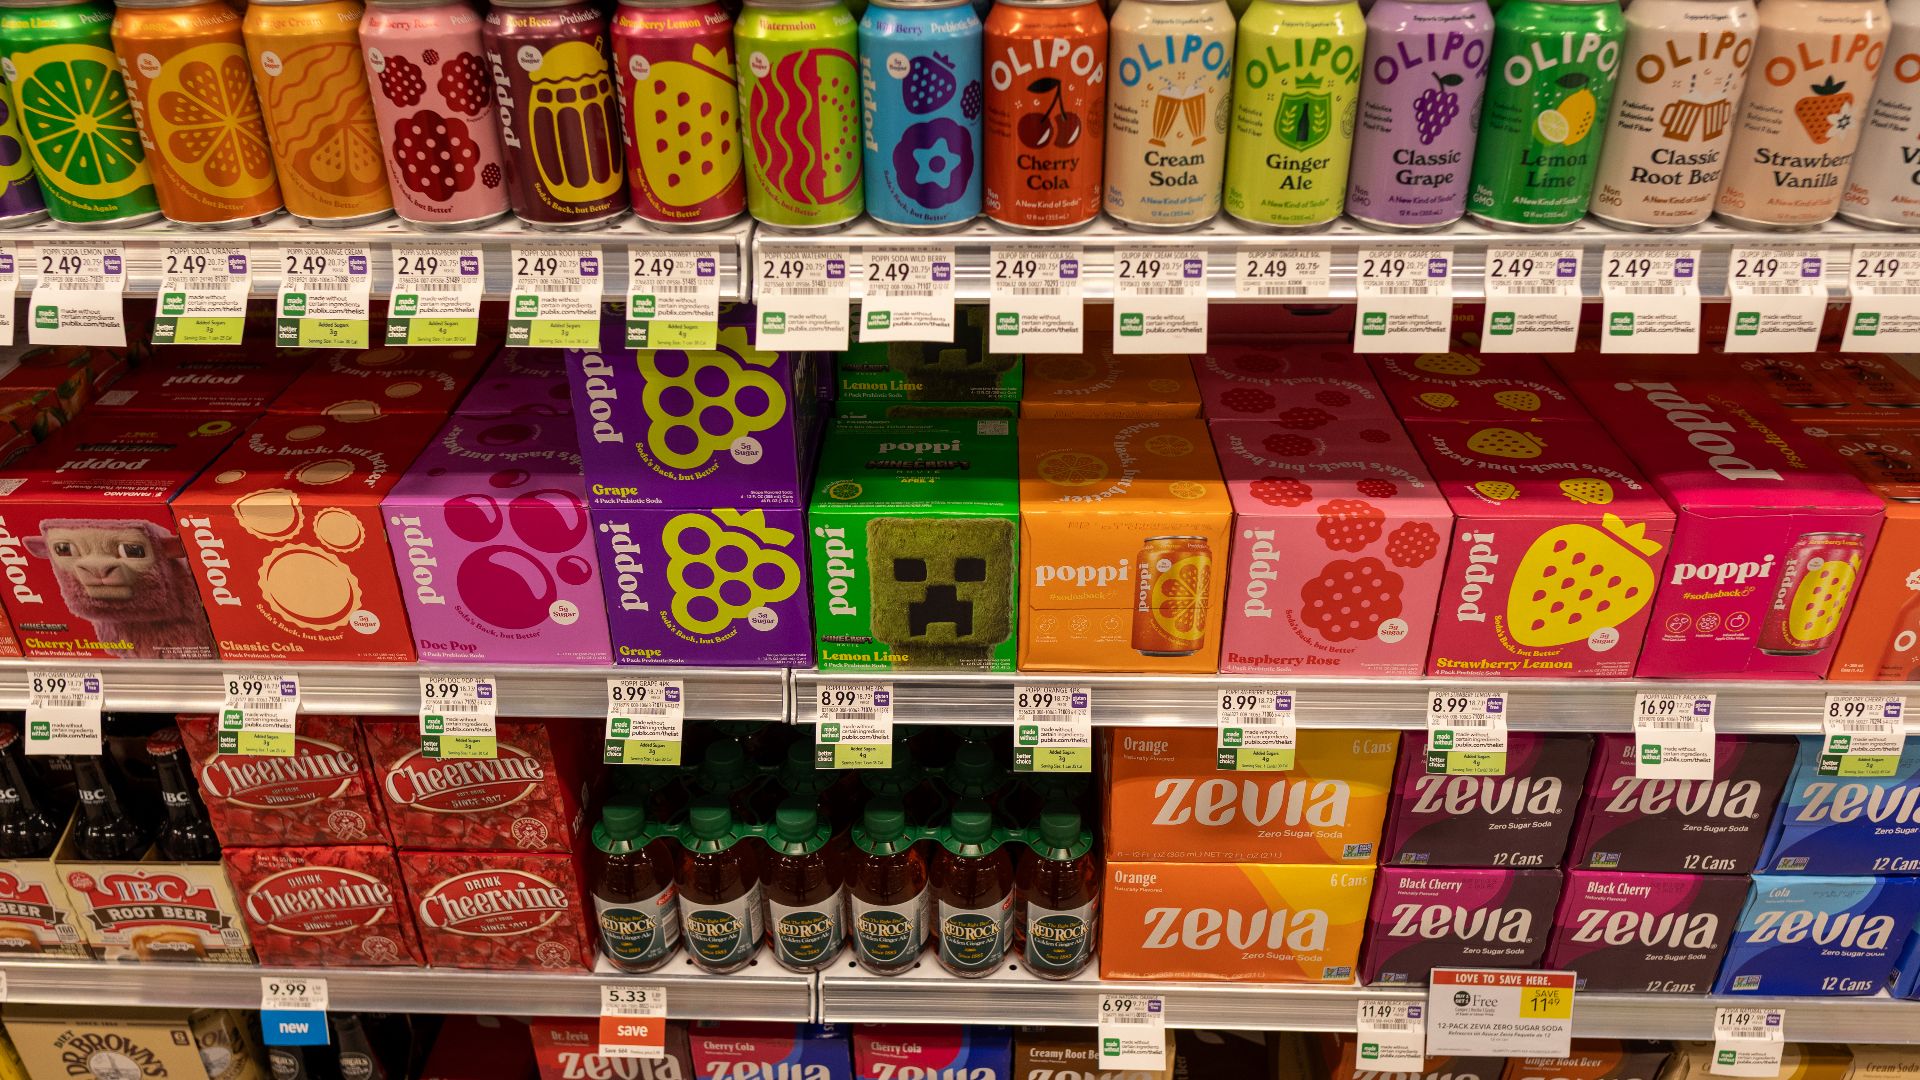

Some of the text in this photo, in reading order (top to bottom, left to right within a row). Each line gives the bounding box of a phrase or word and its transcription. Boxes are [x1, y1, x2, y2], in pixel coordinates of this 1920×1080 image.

[665, 18, 700, 30] Lemon
[759, 19, 816, 31] Watermelon
[990, 38, 1104, 91] OLIPOP
[1017, 153, 1080, 173] Cherry
[1144, 150, 1205, 168] Cream
[1266, 153, 1331, 174] Ginger
[1393, 149, 1461, 167] Classic
[1521, 149, 1587, 167] Lemon
[1652, 149, 1720, 165] Classic
[1026, 174, 1069, 191] Cola
[1149, 171, 1199, 188] Soda
[1279, 175, 1312, 190] Ale
[1396, 170, 1454, 189] Grape
[1527, 172, 1575, 189] Lime
[1631, 168, 1686, 184] Root
[1772, 171, 1838, 188] Vanilla
[1476, 184, 1494, 196] Non
[43, 257, 81, 273] 2.49
[167, 256, 206, 273] 2.49
[287, 256, 326, 274] 2.49
[398, 257, 438, 275] 2.49
[517, 257, 557, 275] 2.49
[634, 258, 674, 276] 2.49
[764, 260, 804, 278] 2.49
[869, 263, 910, 281] 2.49
[995, 260, 1037, 278] 2.49
[1119, 260, 1160, 278] 2.49
[1247, 260, 1287, 278] 2.49
[1363, 259, 1405, 278] 2.49
[1491, 259, 1534, 278] 2.49
[1608, 259, 1651, 278] 2.49
[1735, 259, 1778, 278] 2.49
[1856, 259, 1899, 278] 2.49
[843, 380, 923, 392] Lemon Lime
[740, 443, 751, 451] 5g
[879, 440, 961, 454] poppi
[592, 484, 638, 498] Grape
[180, 514, 242, 606] poppi
[391, 513, 446, 607] poppi
[600, 521, 649, 612] poppi
[815, 527, 857, 616] poppi
[1035, 559, 1129, 587] poppi
[1244, 528, 1280, 618] poppi
[1457, 529, 1499, 622] poppi
[1671, 554, 1776, 585] poppi
[1683, 590, 1741, 600] #sodasback
[25, 638, 134, 651] Cherry Limeade
[221, 641, 269, 652] Classic
[275, 641, 304, 652] Cola
[420, 639, 477, 654] Doc Pop
[619, 645, 661, 658] Grape
[822, 650, 909, 662] Lemon Lime
[1228, 653, 1341, 667] Raspberry Rose
[1436, 657, 1524, 672] Strawberry
[1527, 658, 1574, 670] Lemon
[33, 679, 67, 693] 8.99
[229, 681, 262, 695] 8.99
[425, 684, 458, 698] 8.99
[612, 686, 647, 701] 8.99
[821, 691, 855, 705] 8.99
[1019, 693, 1053, 708] 8.99
[1222, 695, 1257, 710] 8.99
[1433, 698, 1468, 712] 8.99
[1640, 700, 1675, 715] 16.99
[1829, 702, 1865, 717] 8.99
[1123, 736, 1169, 752] Orange
[1352, 739, 1392, 754] 6 Cans
[202, 749, 359, 798] Cheerwine
[385, 748, 545, 805] Cheerwine
[1152, 778, 1350, 827] zevia
[1411, 775, 1562, 815] zevia
[1604, 776, 1761, 819] zevia
[1257, 829, 1343, 840] Zero Sugar Soda
[465, 876, 502, 892] DRINK
[1114, 870, 1156, 886] Orange
[1400, 878, 1462, 892] Black Cherry
[113, 880, 183, 903] IBC
[1587, 882, 1651, 898] Black Cherry
[247, 879, 393, 926] Cheerwine
[419, 882, 569, 928] Cheerwine
[111, 906, 208, 922] ROOT BEER
[941, 920, 1000, 939] RED ROCK
[1142, 907, 1329, 951] zevia
[1388, 904, 1532, 943] zevia
[1571, 908, 1718, 949] zevia
[1746, 911, 1895, 950] zevia
[1455, 974, 1551, 985] LOVE TO SAVE HERE.
[1822, 977, 1872, 991] 12 Cans
[269, 984, 306, 996] 9.99
[609, 990, 646, 1003] 5.33
[1535, 990, 1559, 998] SAVE
[1102, 1000, 1132, 1012] 6.99
[1473, 995, 1499, 1008] Free
[1362, 1006, 1391, 1018] 11.49
[1721, 1014, 1750, 1026] 11.49
[279, 1021, 309, 1034] new
[617, 1024, 648, 1037] save
[1438, 1022, 1468, 1030] 12-PACK
[1541, 1024, 1563, 1032] SODA
[704, 1041, 755, 1053] Cherry Cola
[1030, 1048, 1085, 1062] Creamy Root
[1866, 1063, 1918, 1072] Cream Soda
